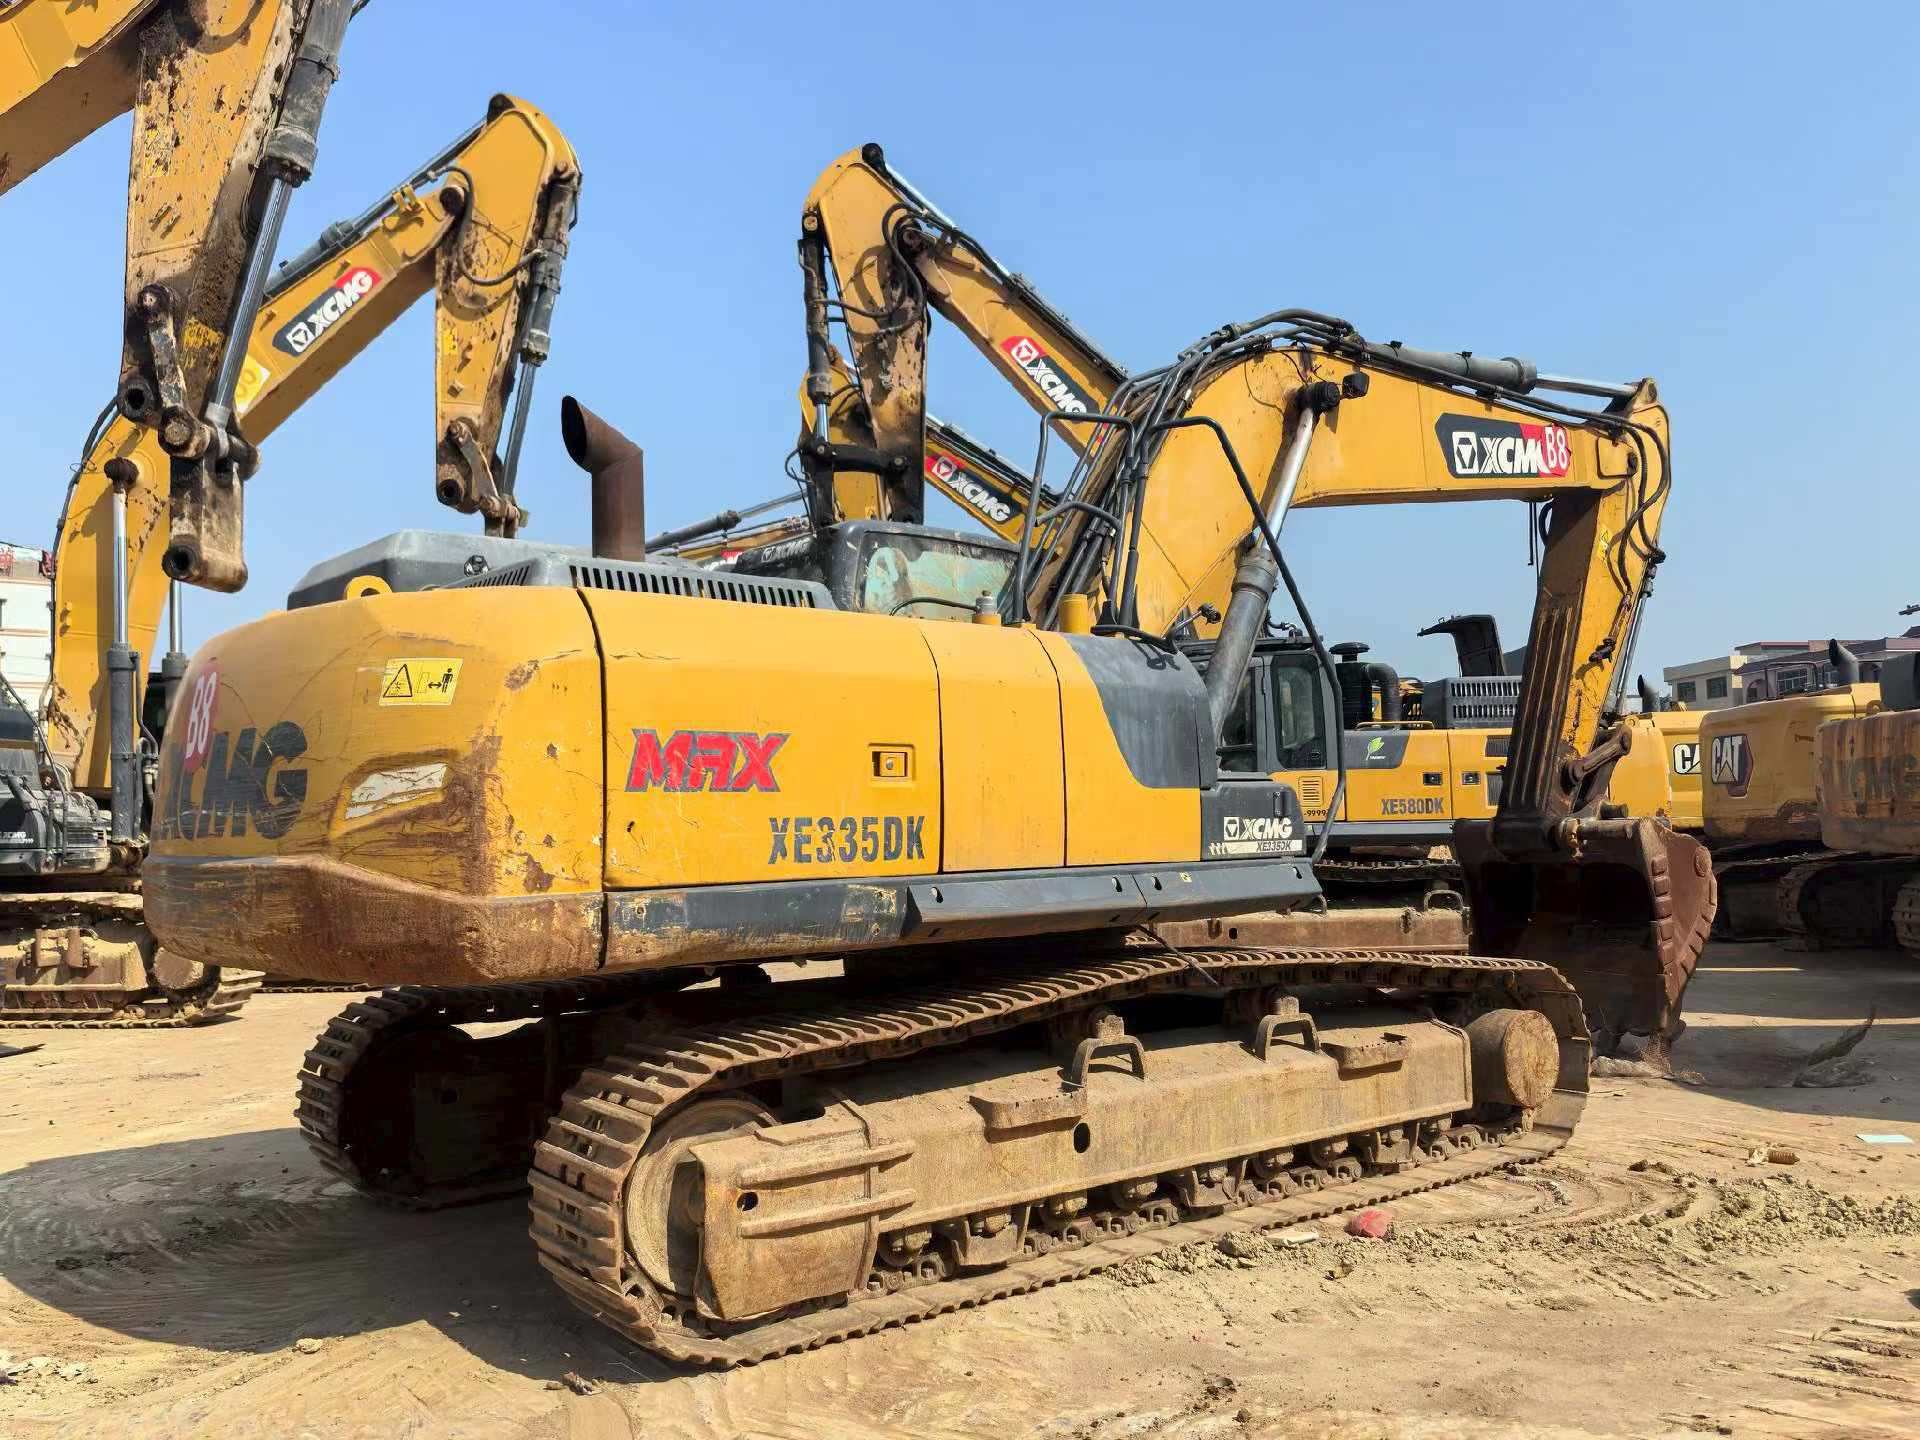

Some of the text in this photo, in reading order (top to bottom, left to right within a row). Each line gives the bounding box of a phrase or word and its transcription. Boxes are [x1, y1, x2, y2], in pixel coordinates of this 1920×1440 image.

[307, 271, 373, 337] XCMG
[1544, 426, 1569, 470] B8
[947, 472, 1010, 522] XCMG
[185, 672, 217, 760] B8
[625, 729, 792, 792] MAX
[1711, 735, 1743, 784] CAT
[1239, 817, 1293, 840] XCMG
[1381, 797, 1445, 815] XE580DK
[768, 816, 926, 864] XE335DK
